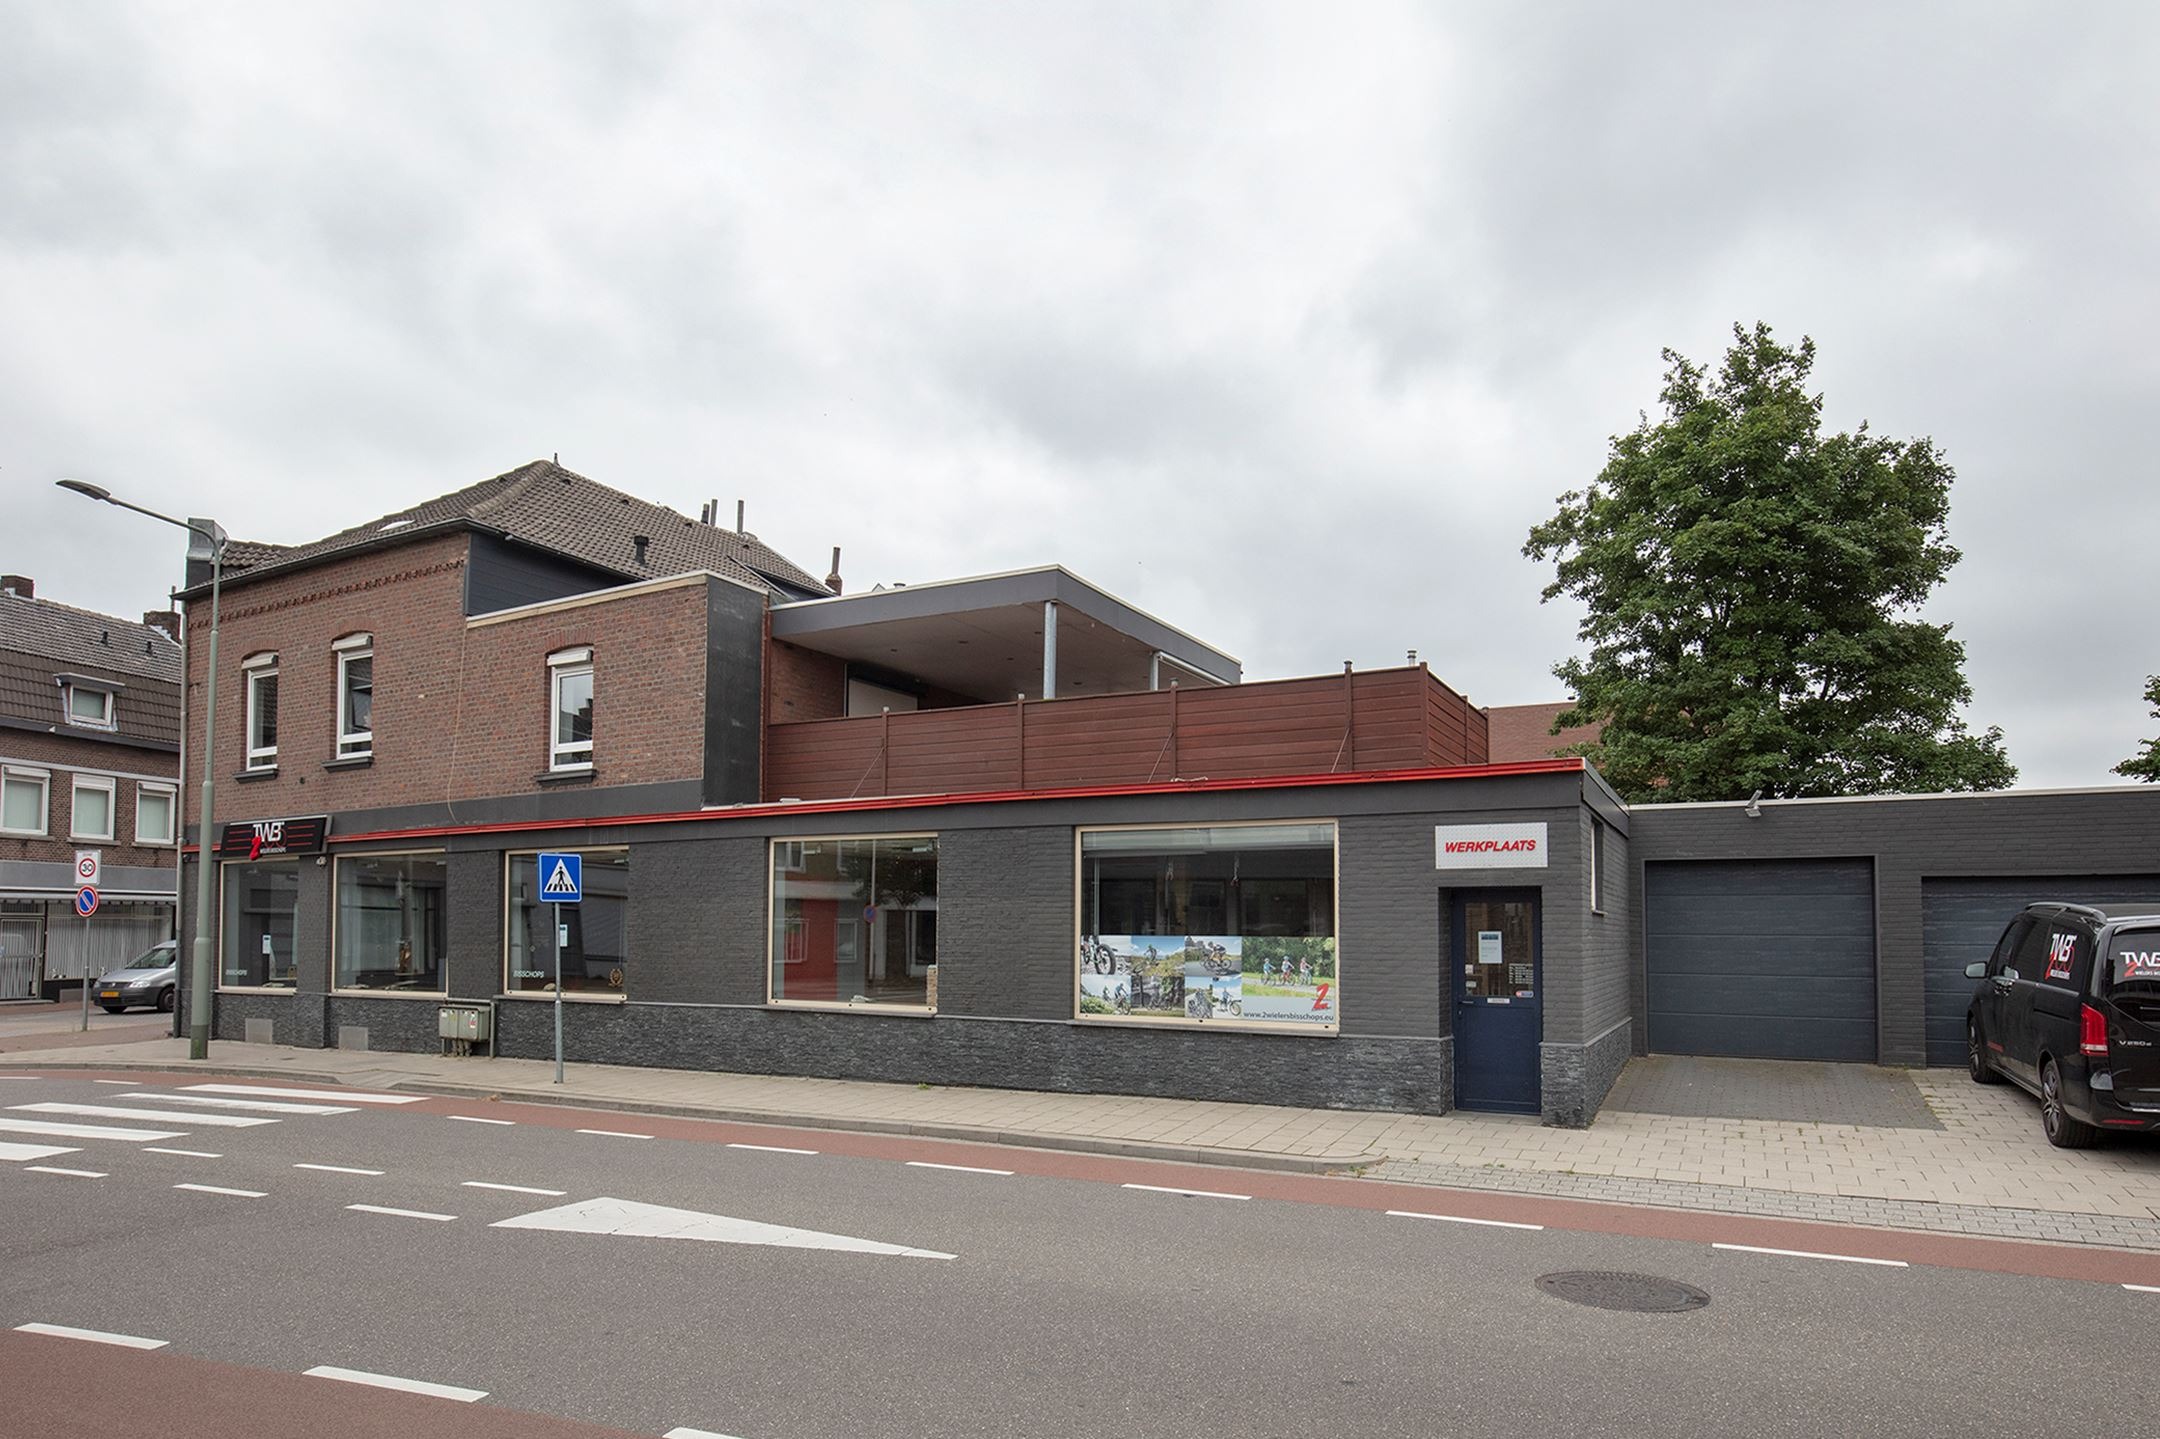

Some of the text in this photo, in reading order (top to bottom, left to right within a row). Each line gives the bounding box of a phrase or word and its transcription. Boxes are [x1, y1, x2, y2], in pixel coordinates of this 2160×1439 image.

[253, 822, 285, 842] TWB
[1445, 840, 1536, 853] WERKPLAATS
[82, 863, 94, 872] 30
[2050, 933, 2077, 962] TWB
[1312, 983, 1329, 1011] 2
[1243, 1011, 1334, 1021] www.2wielersbisschops.eu
